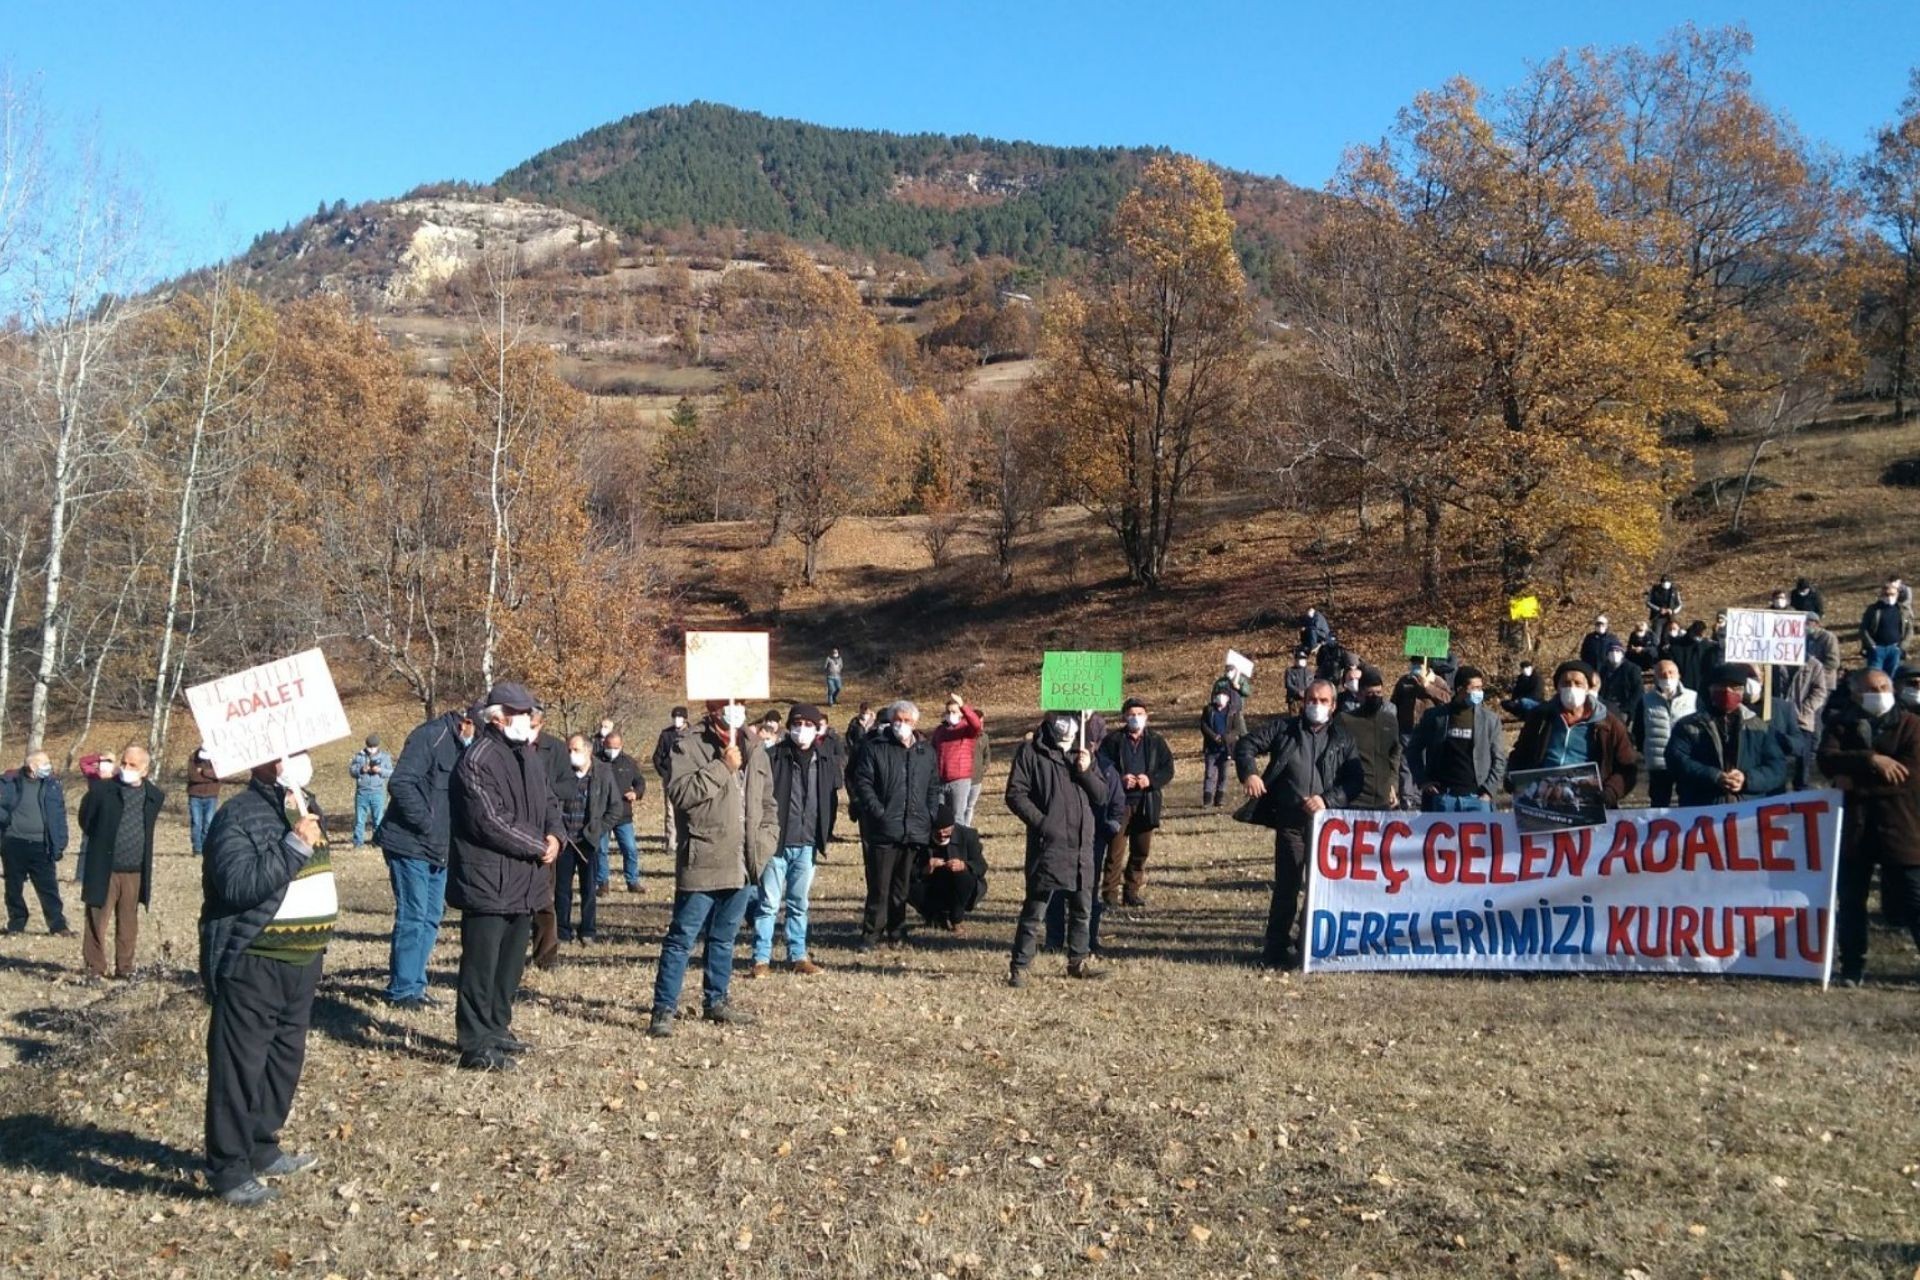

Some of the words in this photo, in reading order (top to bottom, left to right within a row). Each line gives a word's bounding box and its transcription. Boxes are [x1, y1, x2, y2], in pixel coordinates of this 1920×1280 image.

[1774, 641, 1803, 661] SEV
[226, 678, 305, 722] ADALET
[1317, 818, 1412, 893] GEÇ
[1423, 822, 1591, 884] GELEN
[1598, 801, 1829, 876] ADALET
[1312, 895, 1595, 958] DERELERİMİZİ
[1606, 906, 1827, 963] KURUTTU
